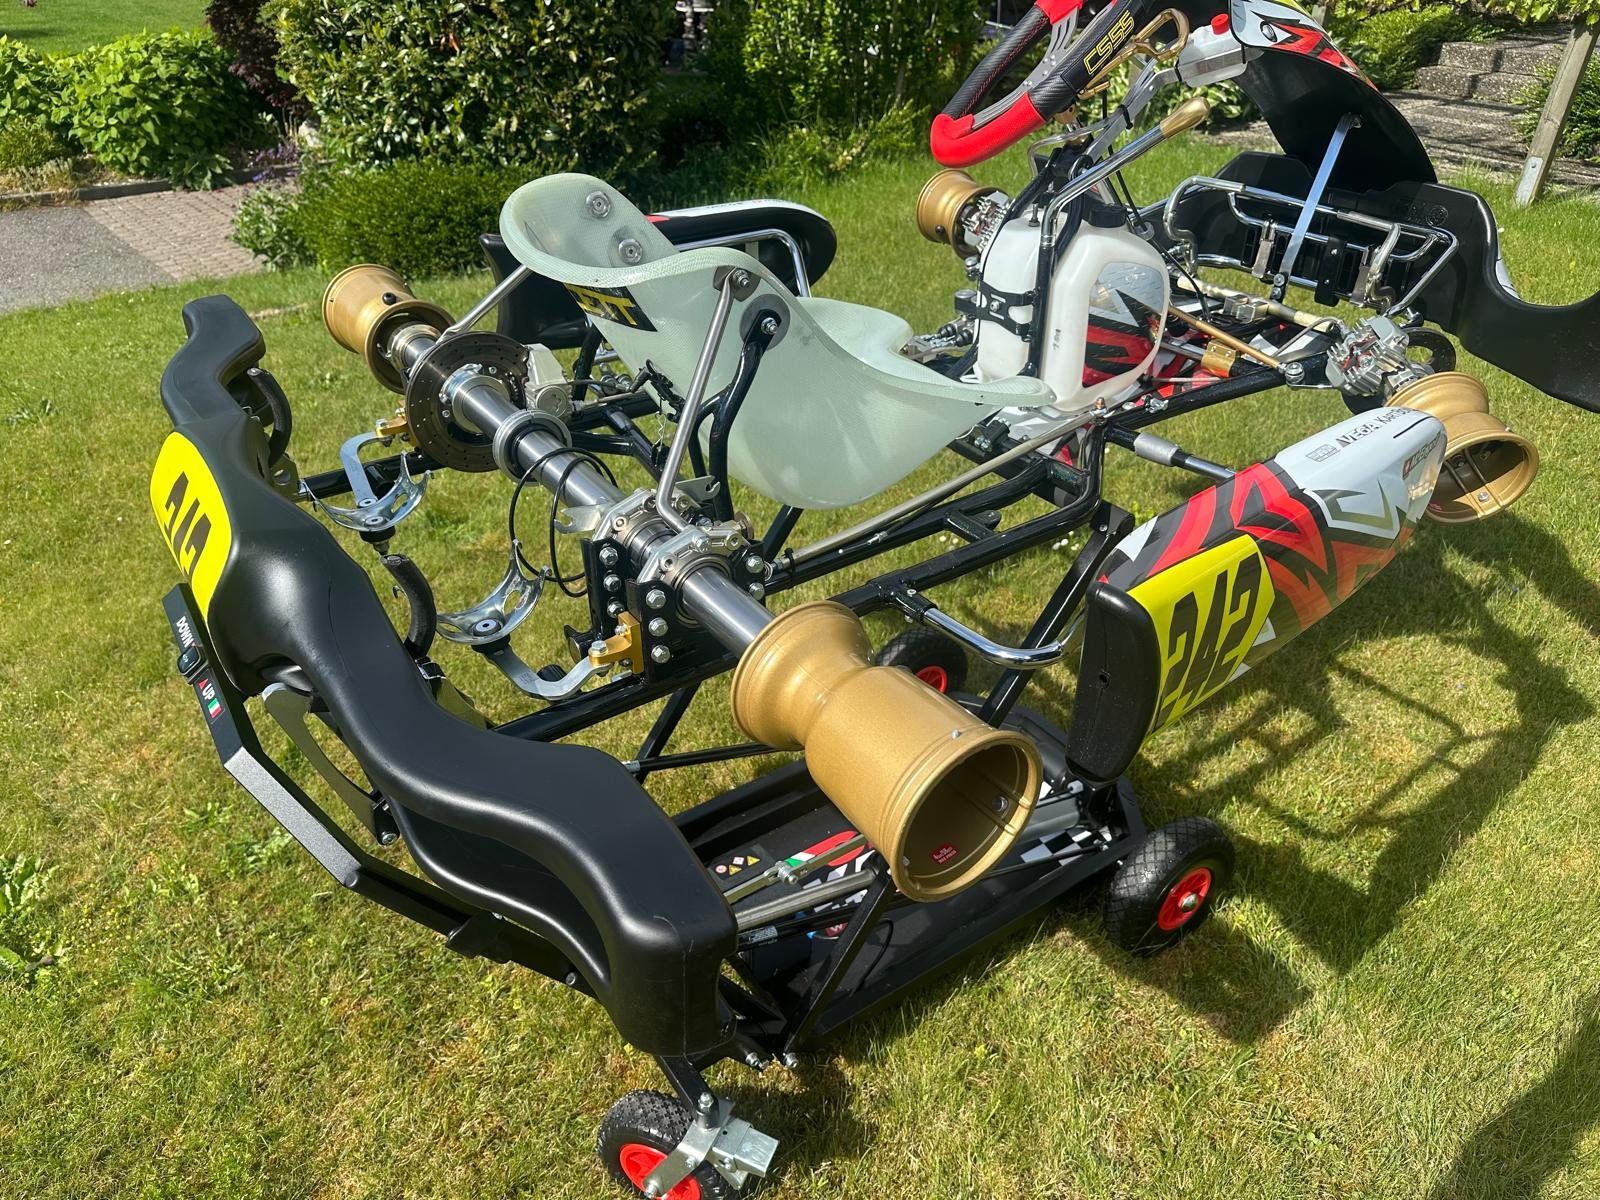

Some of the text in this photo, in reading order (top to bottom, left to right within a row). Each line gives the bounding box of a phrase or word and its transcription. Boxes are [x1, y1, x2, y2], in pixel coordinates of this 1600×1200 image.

[176, 616, 194, 648] DOWN
[1156, 552, 1262, 728] 242
[202, 683, 216, 700] UP
